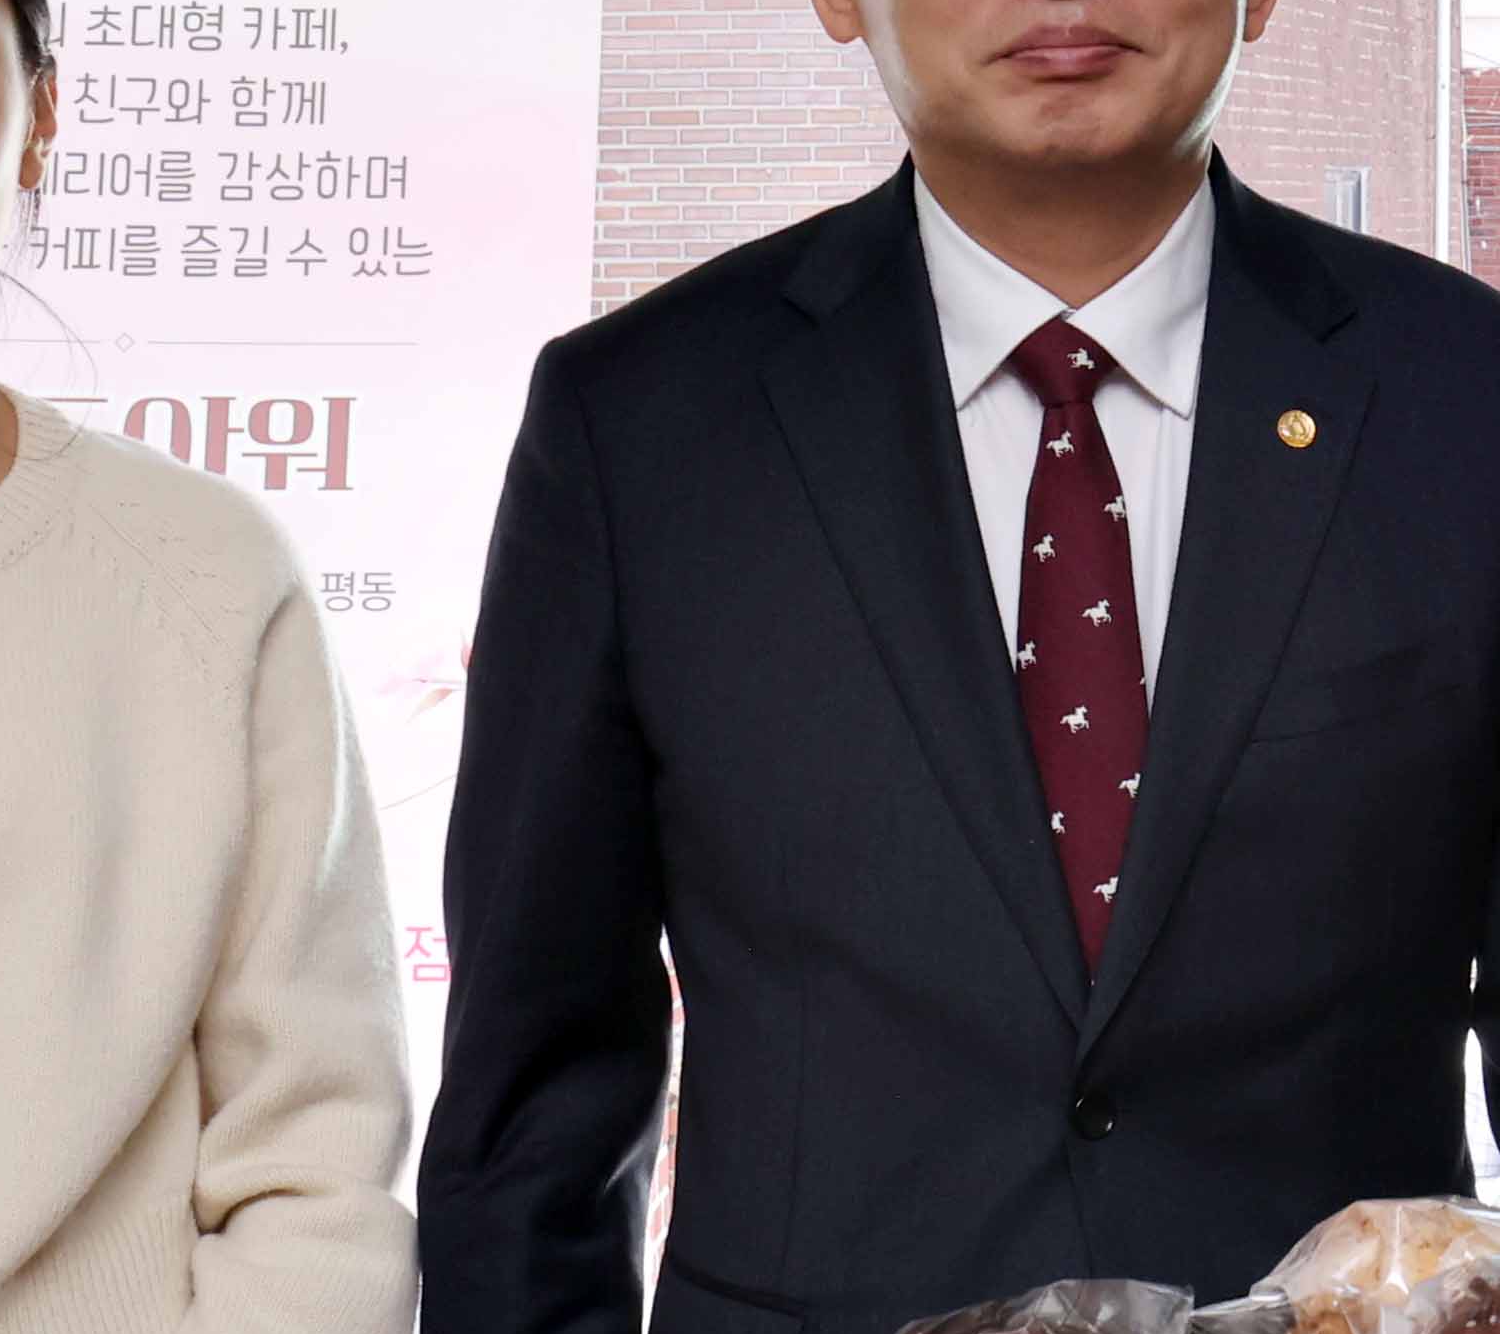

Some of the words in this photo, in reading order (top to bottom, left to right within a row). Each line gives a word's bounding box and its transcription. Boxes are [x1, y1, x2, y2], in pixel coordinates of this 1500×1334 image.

[84, 1, 224, 52] 초대형
[243, 7, 349, 55] 카페,
[73, 73, 211, 125] 친구와
[231, 76, 327, 127] 함께
[216, 151, 408, 202] 감상하며
[30, 225, 161, 277] 커피를
[181, 225, 269, 277] 즐길
[286, 228, 327, 276] 수
[348, 226, 433, 277] 있는
[69, 396, 357, 492] 아워
